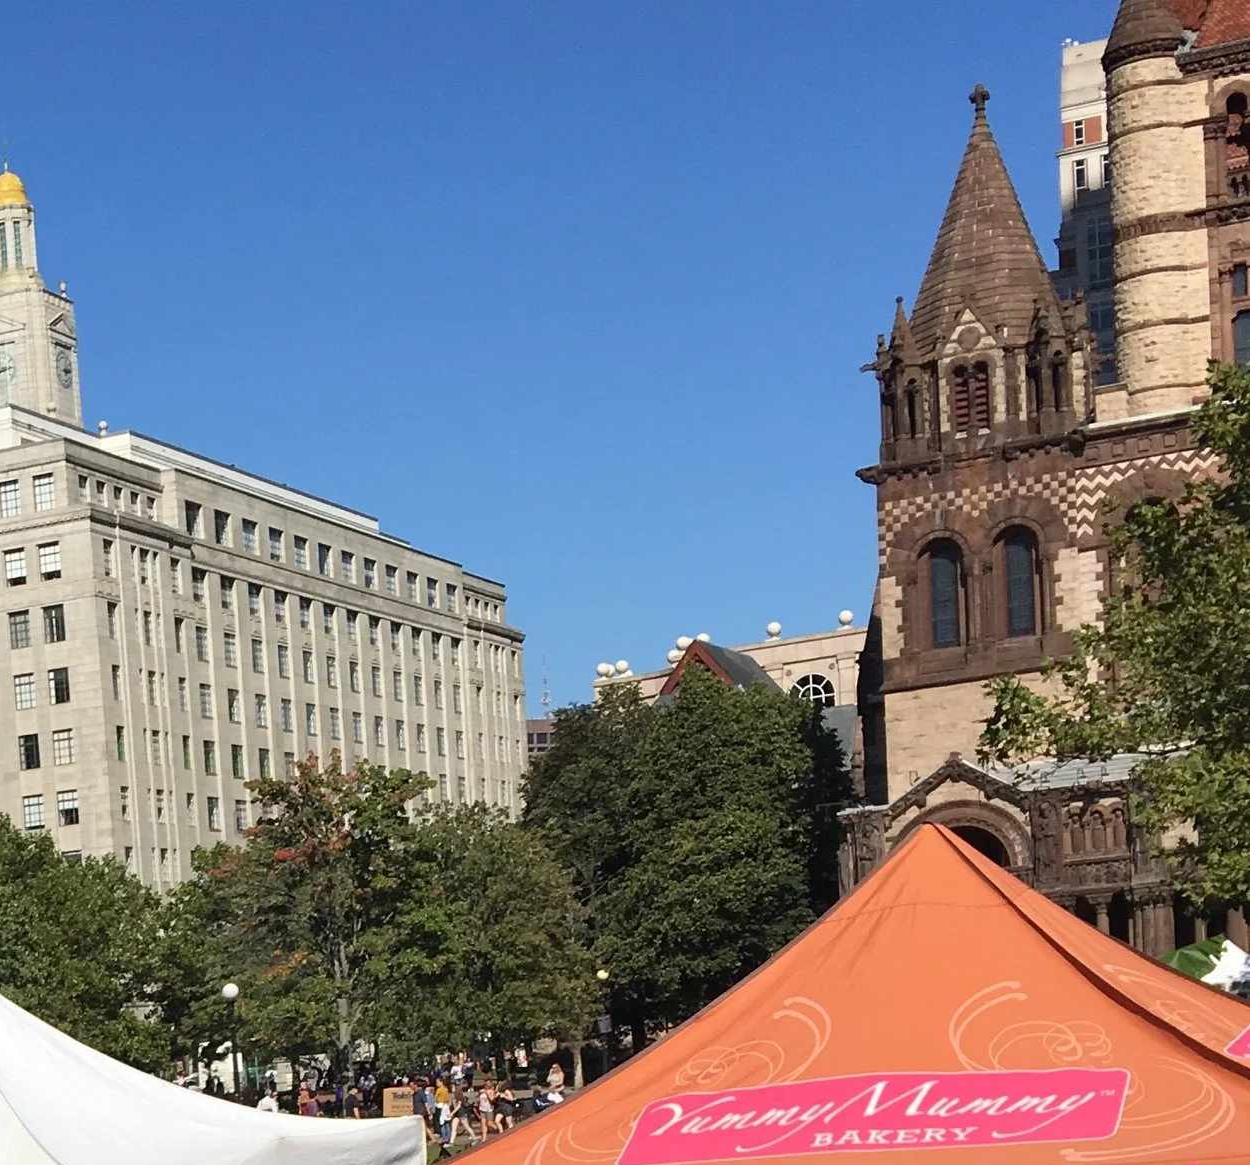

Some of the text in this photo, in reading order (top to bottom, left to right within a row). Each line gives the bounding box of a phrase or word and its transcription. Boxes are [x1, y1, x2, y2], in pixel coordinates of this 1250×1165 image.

[649, 1096, 836, 1153] Yummy
[823, 1080, 1096, 1139] Mummy
[809, 1126, 979, 1148] BAKERY
